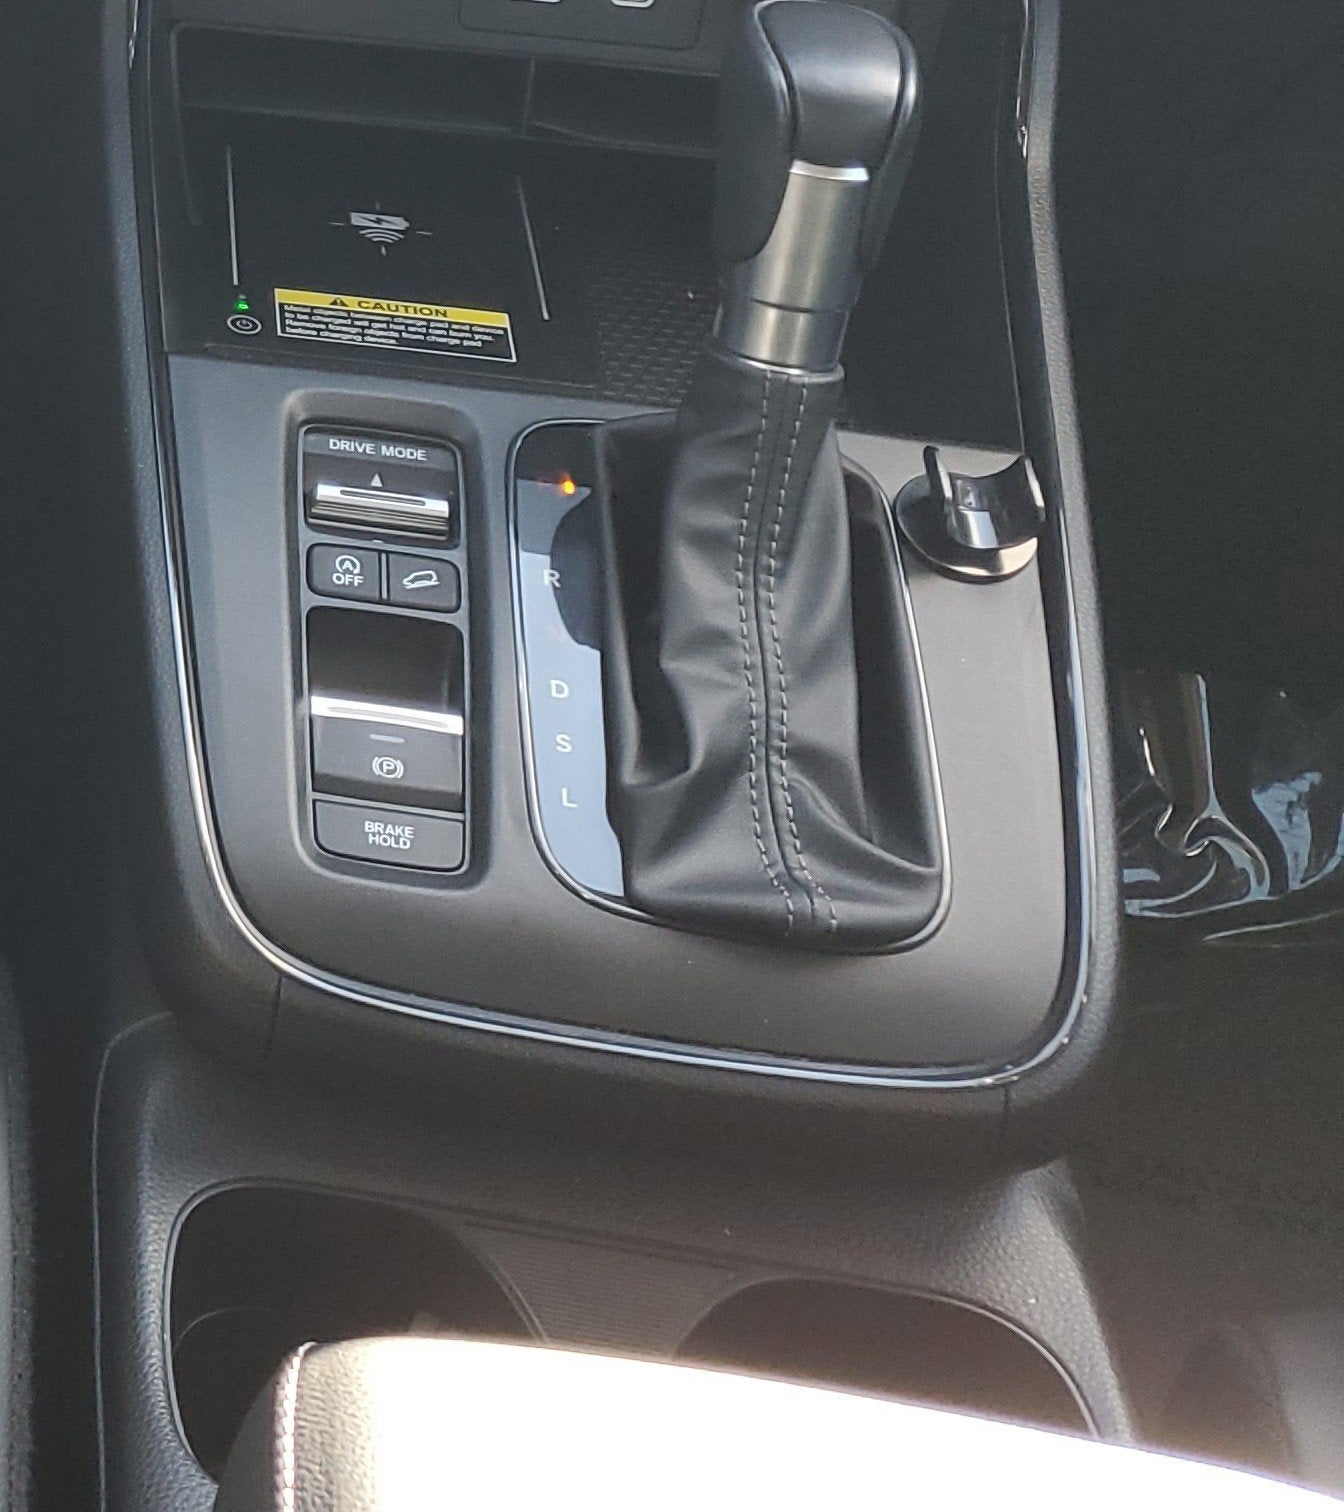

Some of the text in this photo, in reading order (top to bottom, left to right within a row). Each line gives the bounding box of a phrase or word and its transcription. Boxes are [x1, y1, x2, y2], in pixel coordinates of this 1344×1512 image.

[357, 300, 448, 318] CAUTION
[329, 438, 427, 461] DRIVE MODE
[332, 572, 364, 587] OFF
[543, 569, 561, 588] R
[550, 680, 569, 698] D
[556, 734, 572, 753] S
[562, 788, 578, 808] L
[364, 821, 414, 838] BRAKE
[368, 832, 411, 849] HOLD
